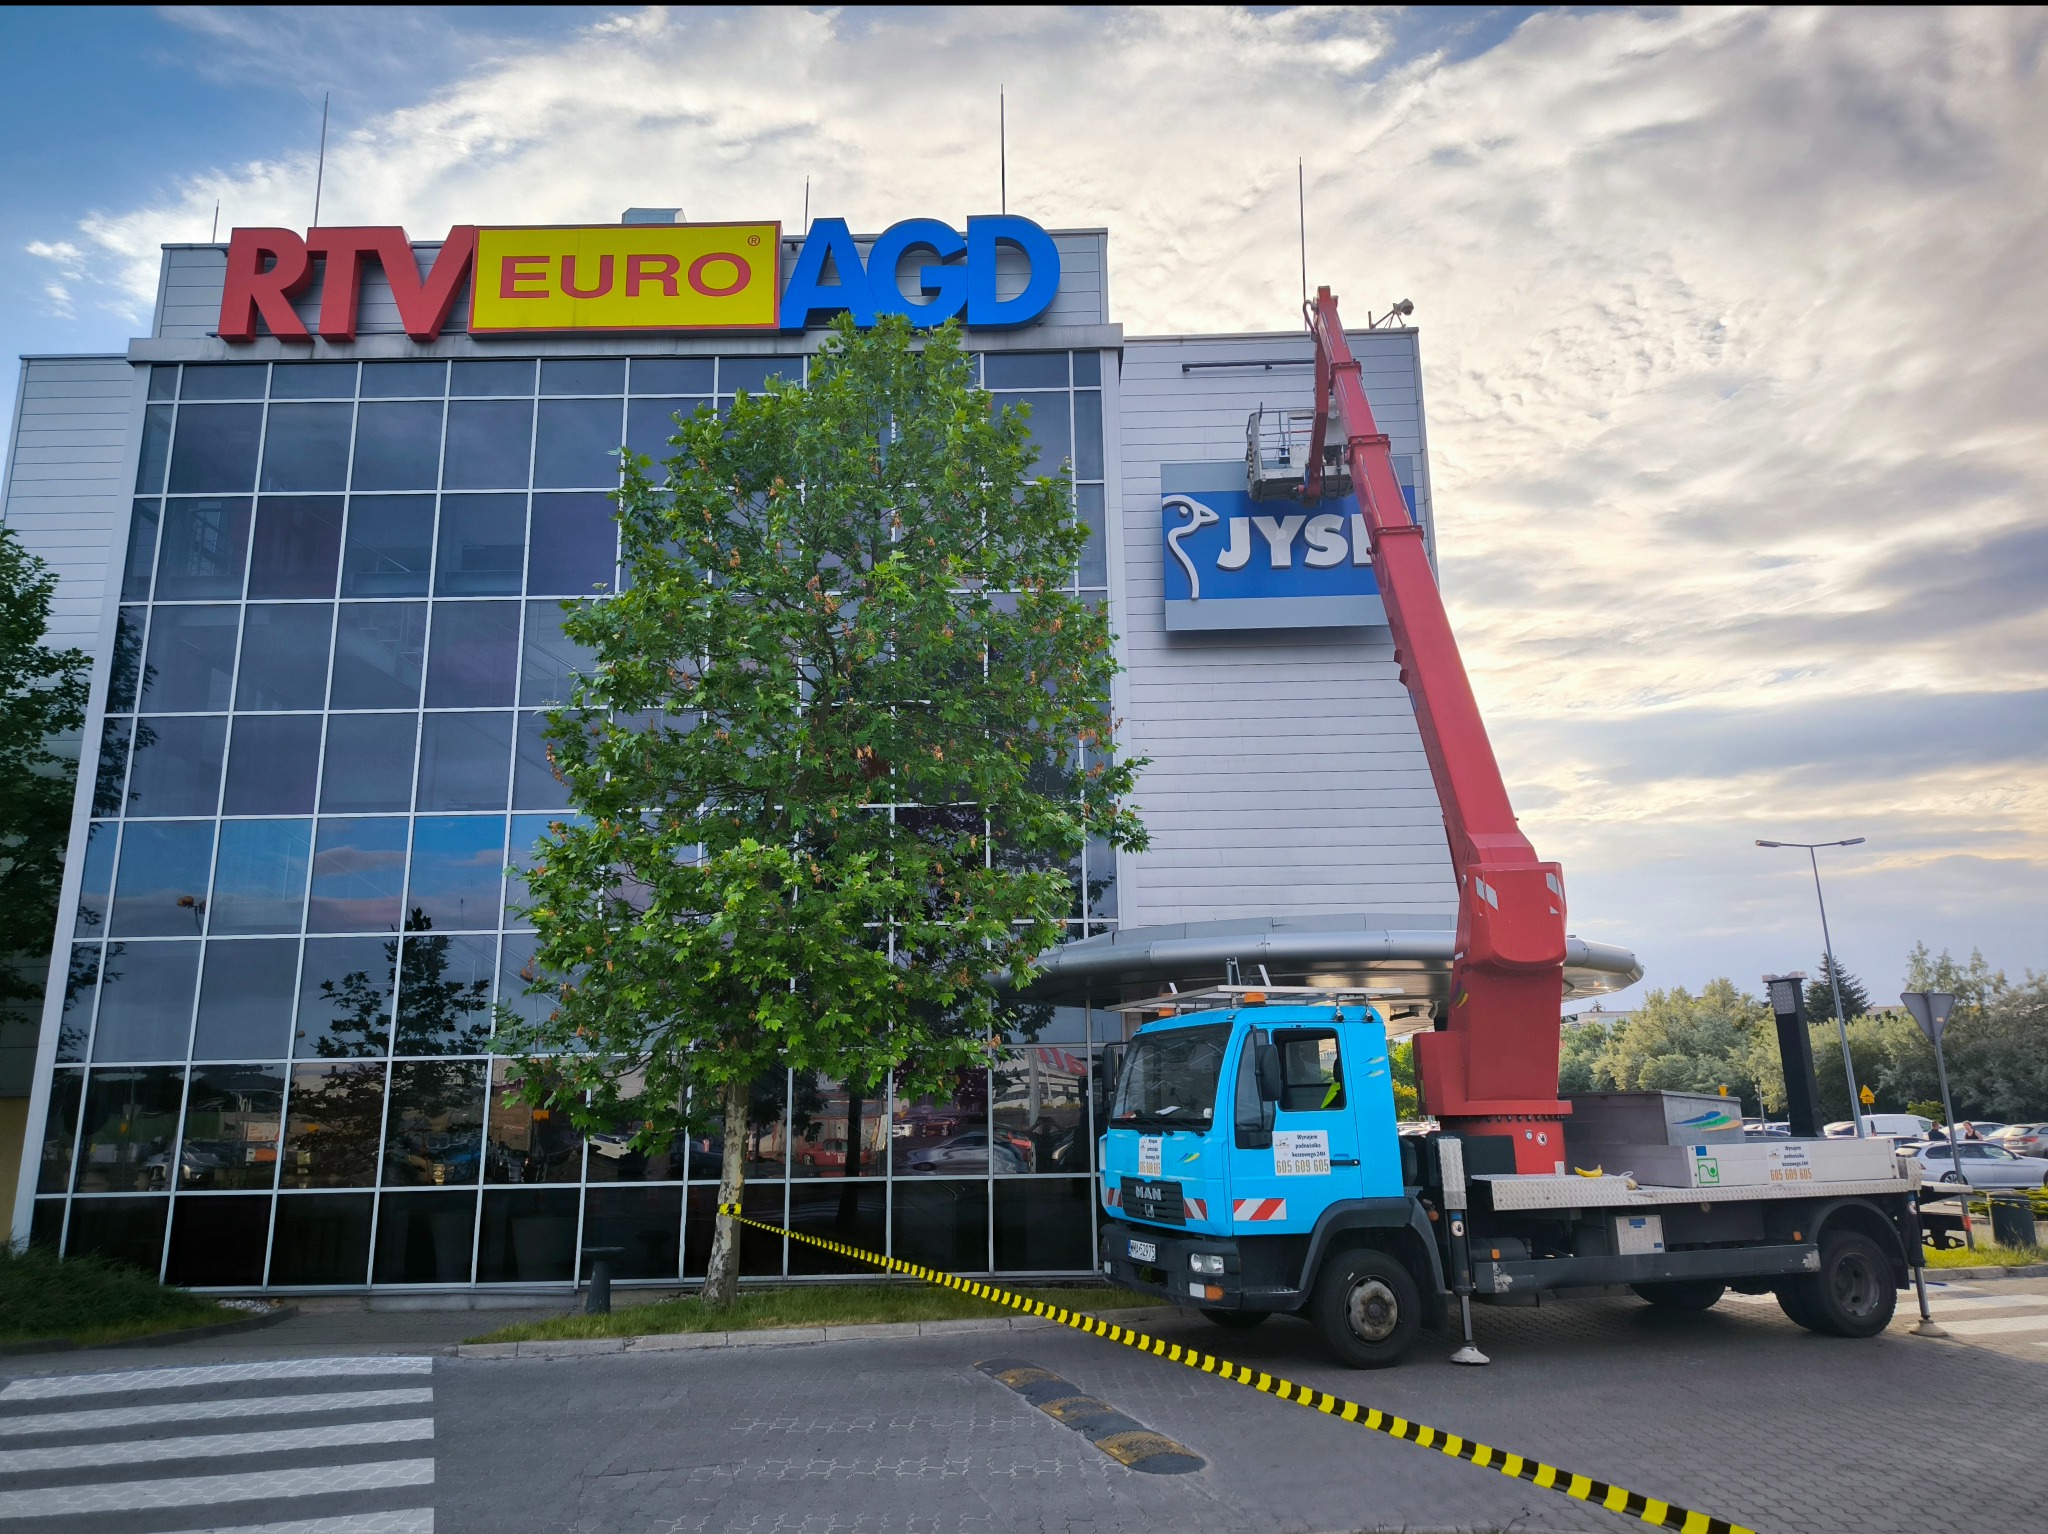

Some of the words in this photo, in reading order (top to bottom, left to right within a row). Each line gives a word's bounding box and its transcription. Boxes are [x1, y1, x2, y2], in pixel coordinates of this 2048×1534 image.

[218, 225, 474, 343] RTV
[499, 252, 752, 299] EURO
[780, 214, 1060, 335] AGD
[1276, 1160, 1292, 1174] 605
[1294, 1159, 1311, 1173] 609
[1313, 1158, 1329, 1172] 605
[1770, 1168, 1784, 1181] 605
[1784, 1168, 1798, 1181] 609
[1799, 1167, 1813, 1180] 605
[1135, 1185, 1162, 1201] MAN
